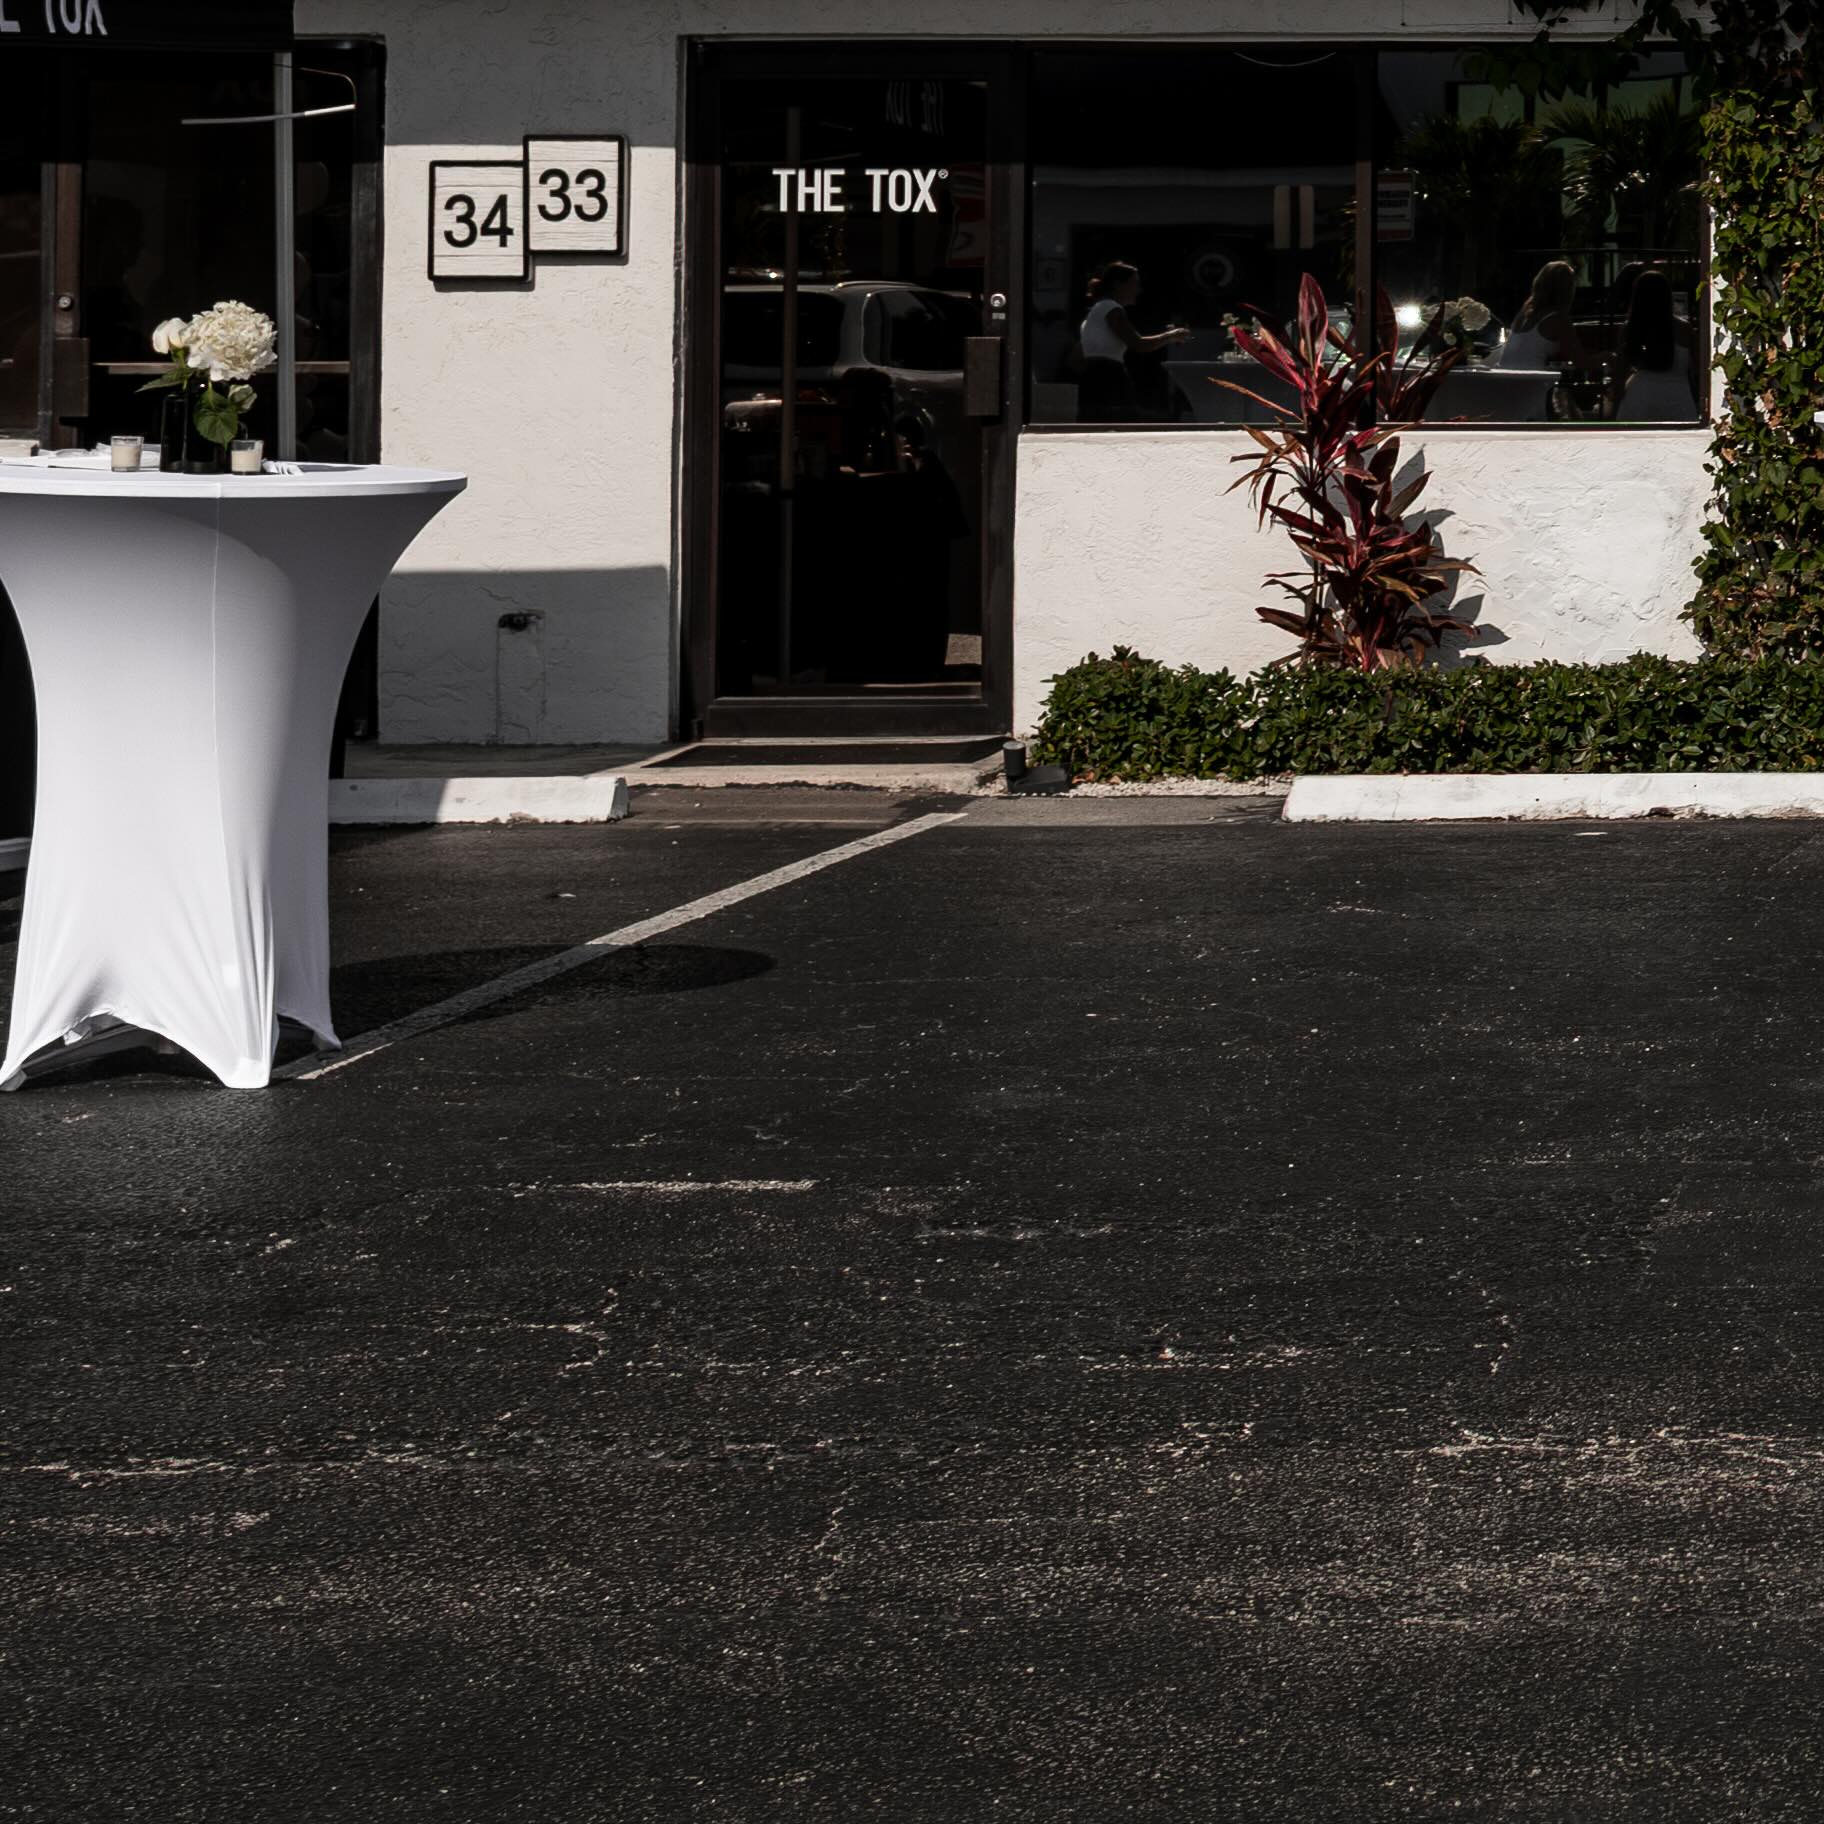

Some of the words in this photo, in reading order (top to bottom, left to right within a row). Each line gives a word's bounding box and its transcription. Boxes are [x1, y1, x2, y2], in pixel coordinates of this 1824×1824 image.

[537, 168, 608, 222] 33
[772, 168, 846, 212] THE
[443, 193, 514, 248] 34
